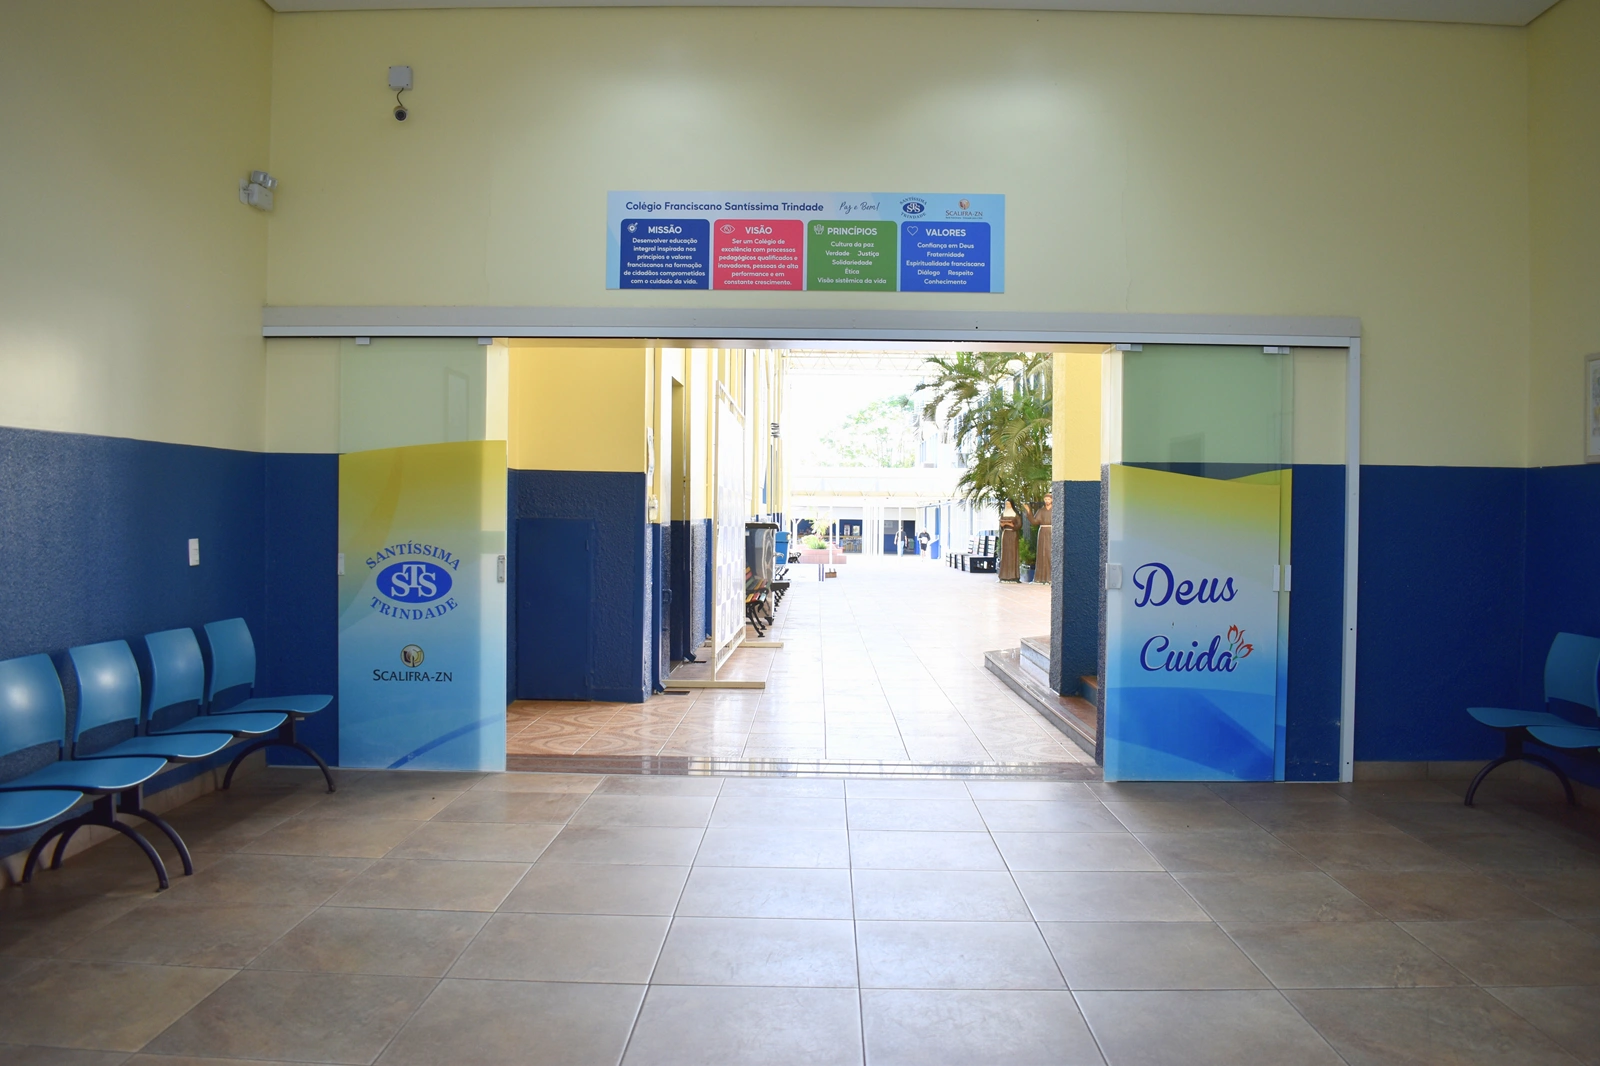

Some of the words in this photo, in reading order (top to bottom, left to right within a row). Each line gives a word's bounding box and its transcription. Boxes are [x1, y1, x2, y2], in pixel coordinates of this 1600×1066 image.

[626, 201, 661, 212] Colégio
[665, 202, 722, 210] Franciscano
[725, 202, 778, 211] Santíssima
[782, 202, 824, 211] Trindade
[648, 224, 682, 234] MISSÃO
[745, 224, 772, 234] VISÃO
[827, 226, 877, 235] PRINCÍPIOS
[926, 228, 966, 236] VALORES
[366, 540, 461, 570] SANTÍSSIMA
[391, 564, 437, 598] STS
[1132, 562, 1238, 608] Deus
[370, 596, 458, 620] TRINDADE
[1140, 635, 1239, 672] Cuida
[373, 669, 452, 682] SCALIFRA-ZN
